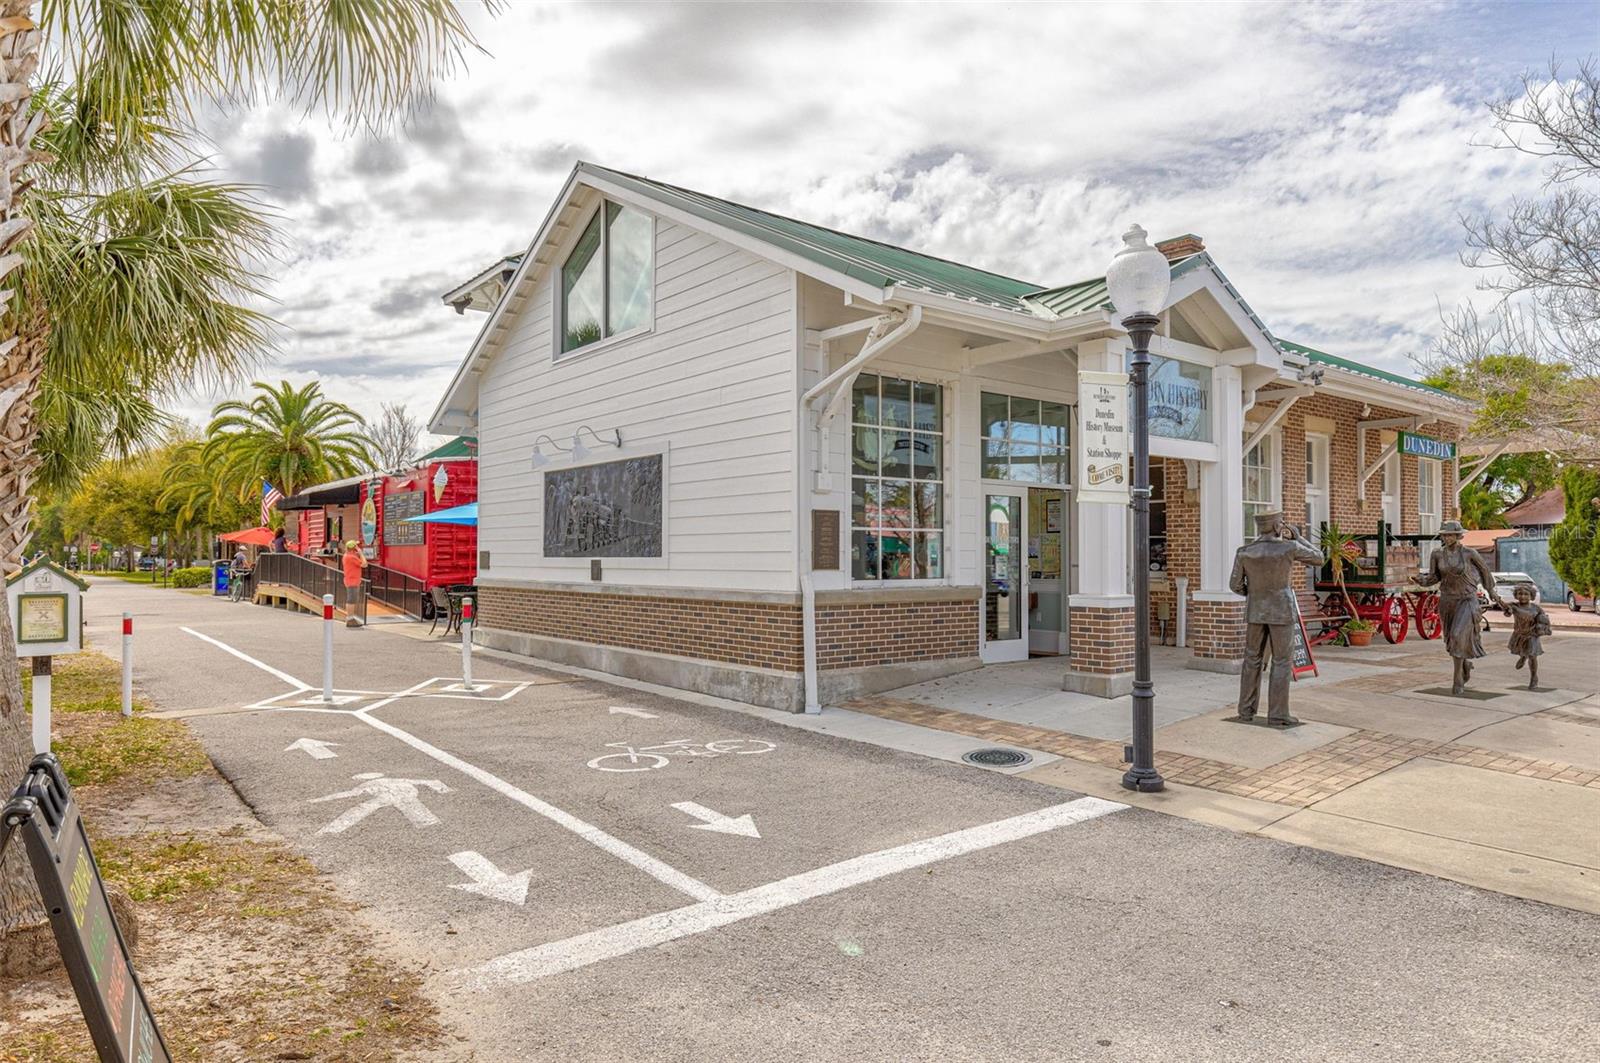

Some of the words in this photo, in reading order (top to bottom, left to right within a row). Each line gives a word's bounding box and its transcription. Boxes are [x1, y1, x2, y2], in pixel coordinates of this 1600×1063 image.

[1168, 383, 1208, 410] HISTORY
[1086, 420, 1102, 433] History
[1104, 422, 1123, 433] Museum
[1102, 435, 1107, 445] &
[1403, 435, 1453, 457] DUNEDIN
[1087, 447, 1104, 457] Station
